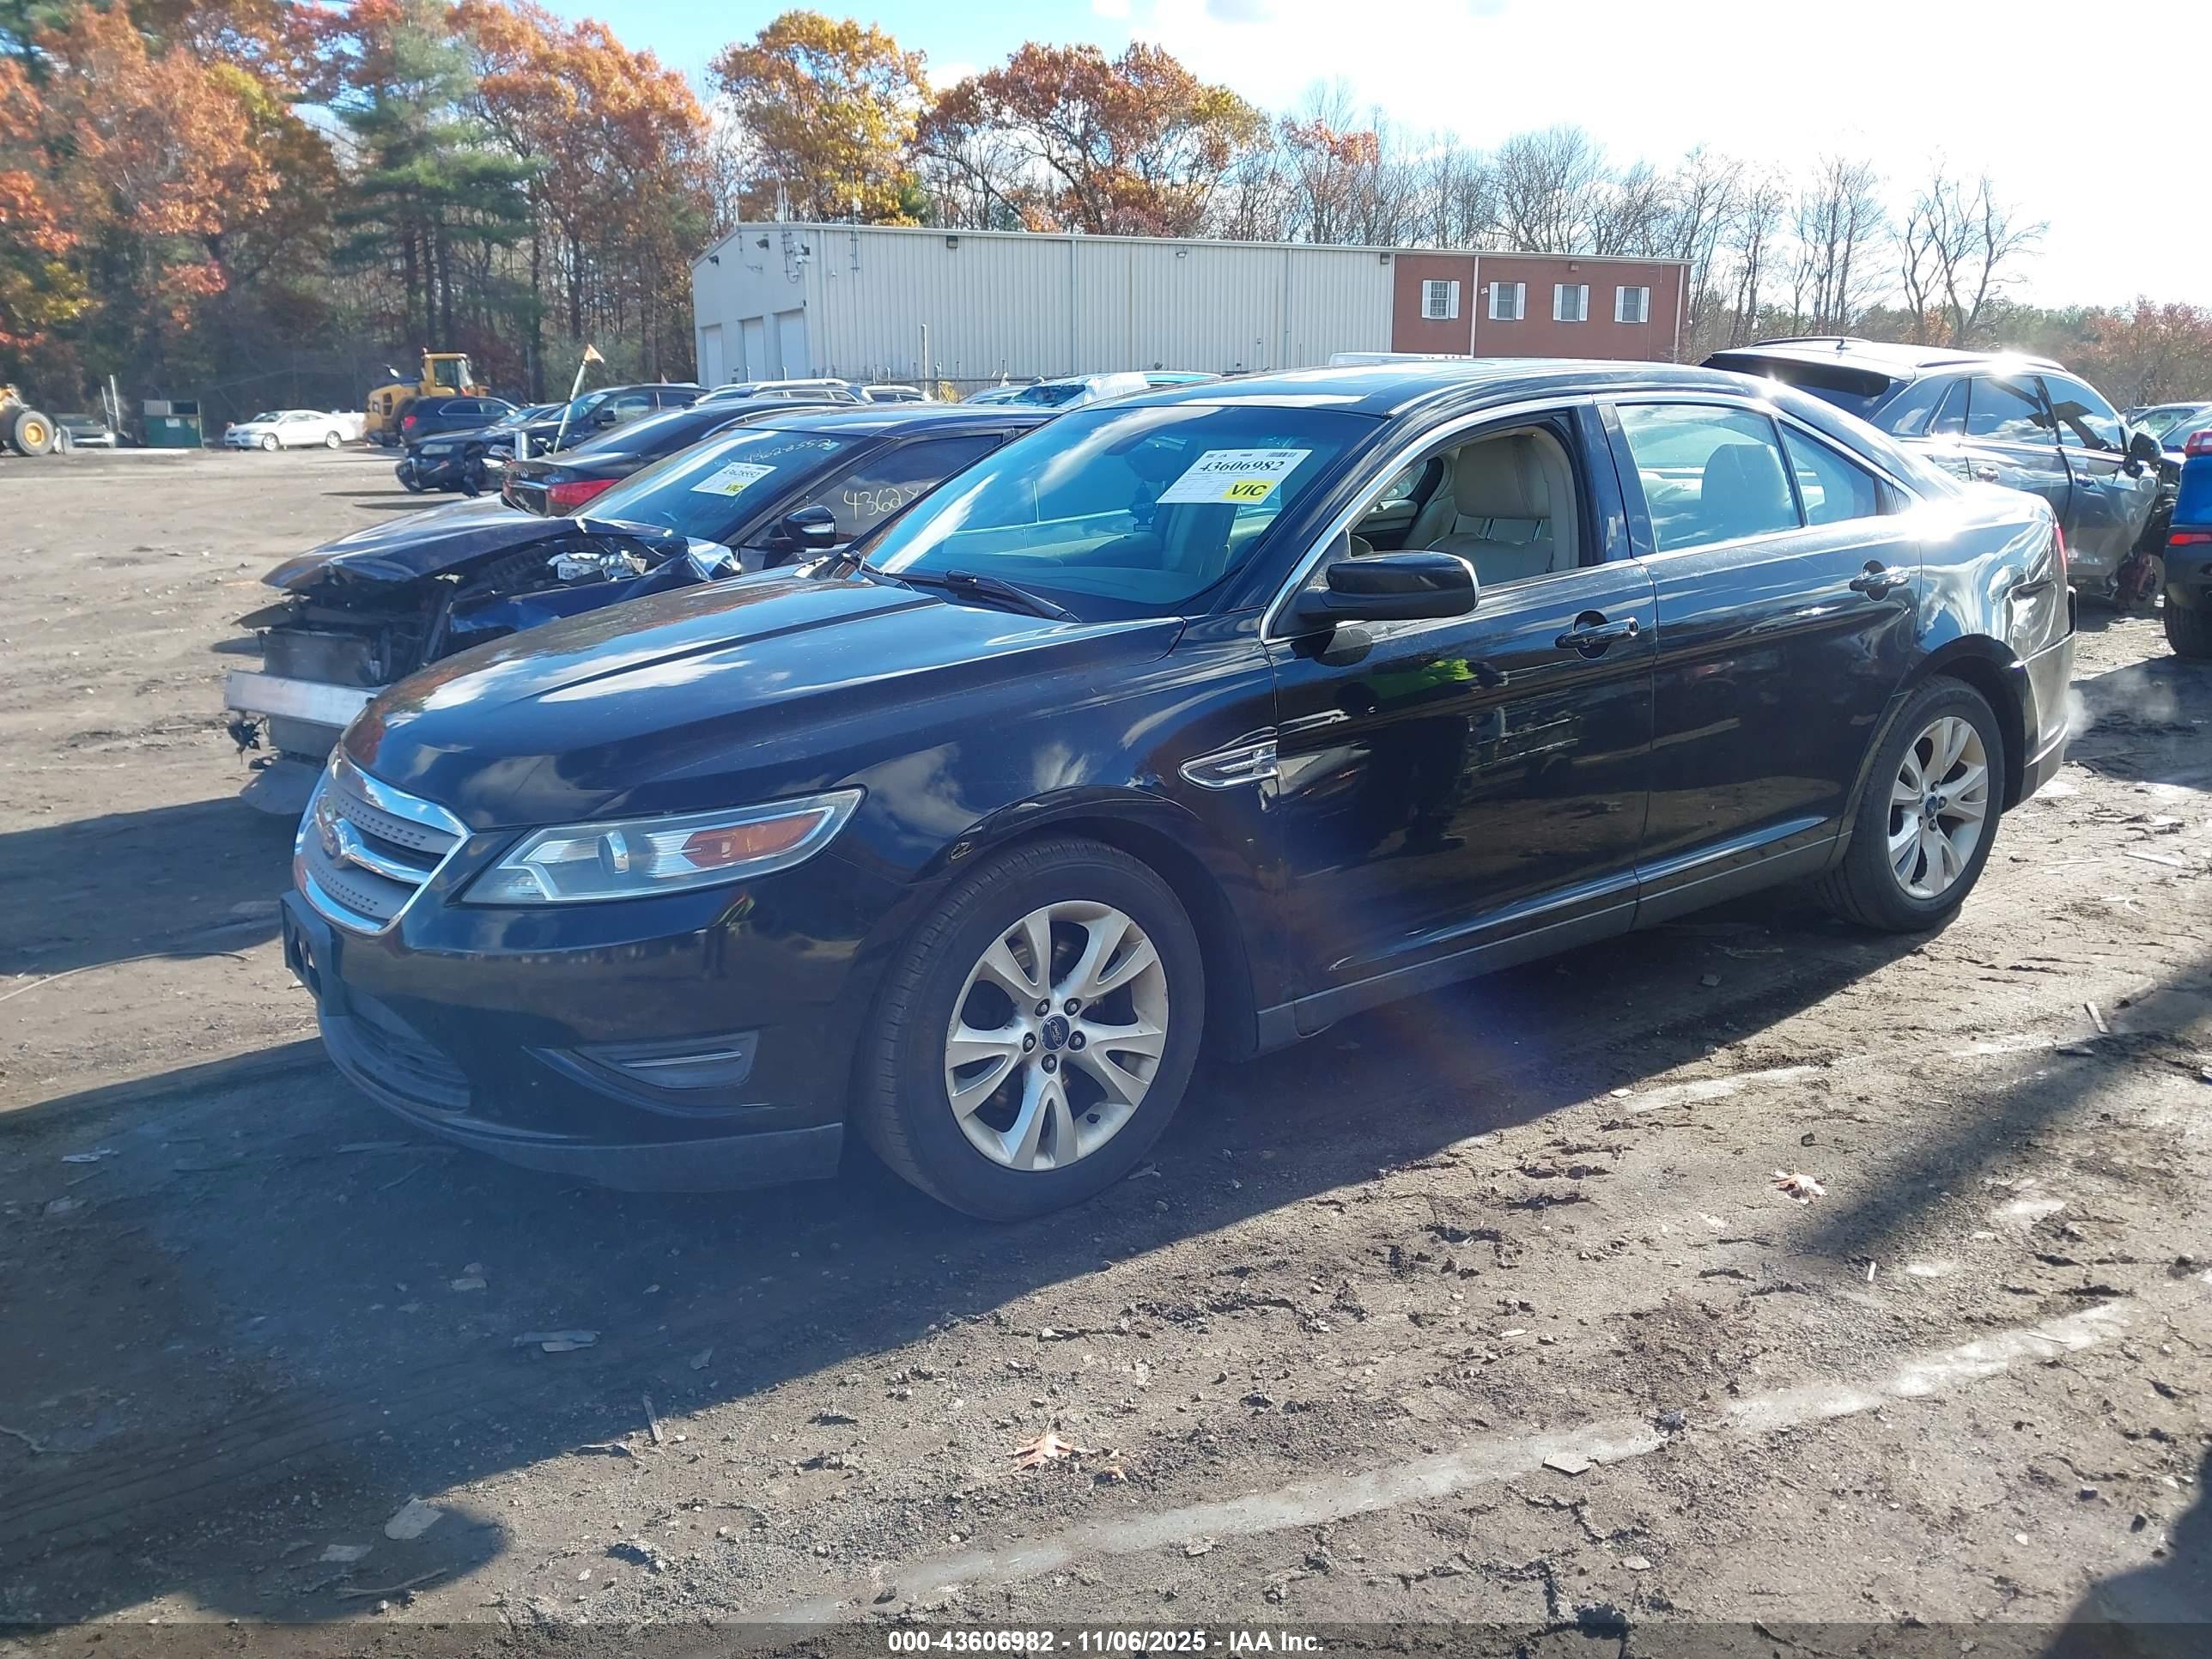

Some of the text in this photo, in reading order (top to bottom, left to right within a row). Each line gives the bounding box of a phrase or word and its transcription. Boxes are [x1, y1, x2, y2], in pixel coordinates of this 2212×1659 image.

[1200, 460, 1285, 472] 43606982
[1231, 483, 1267, 496] VIC
[843, 483, 935, 521] 4362
